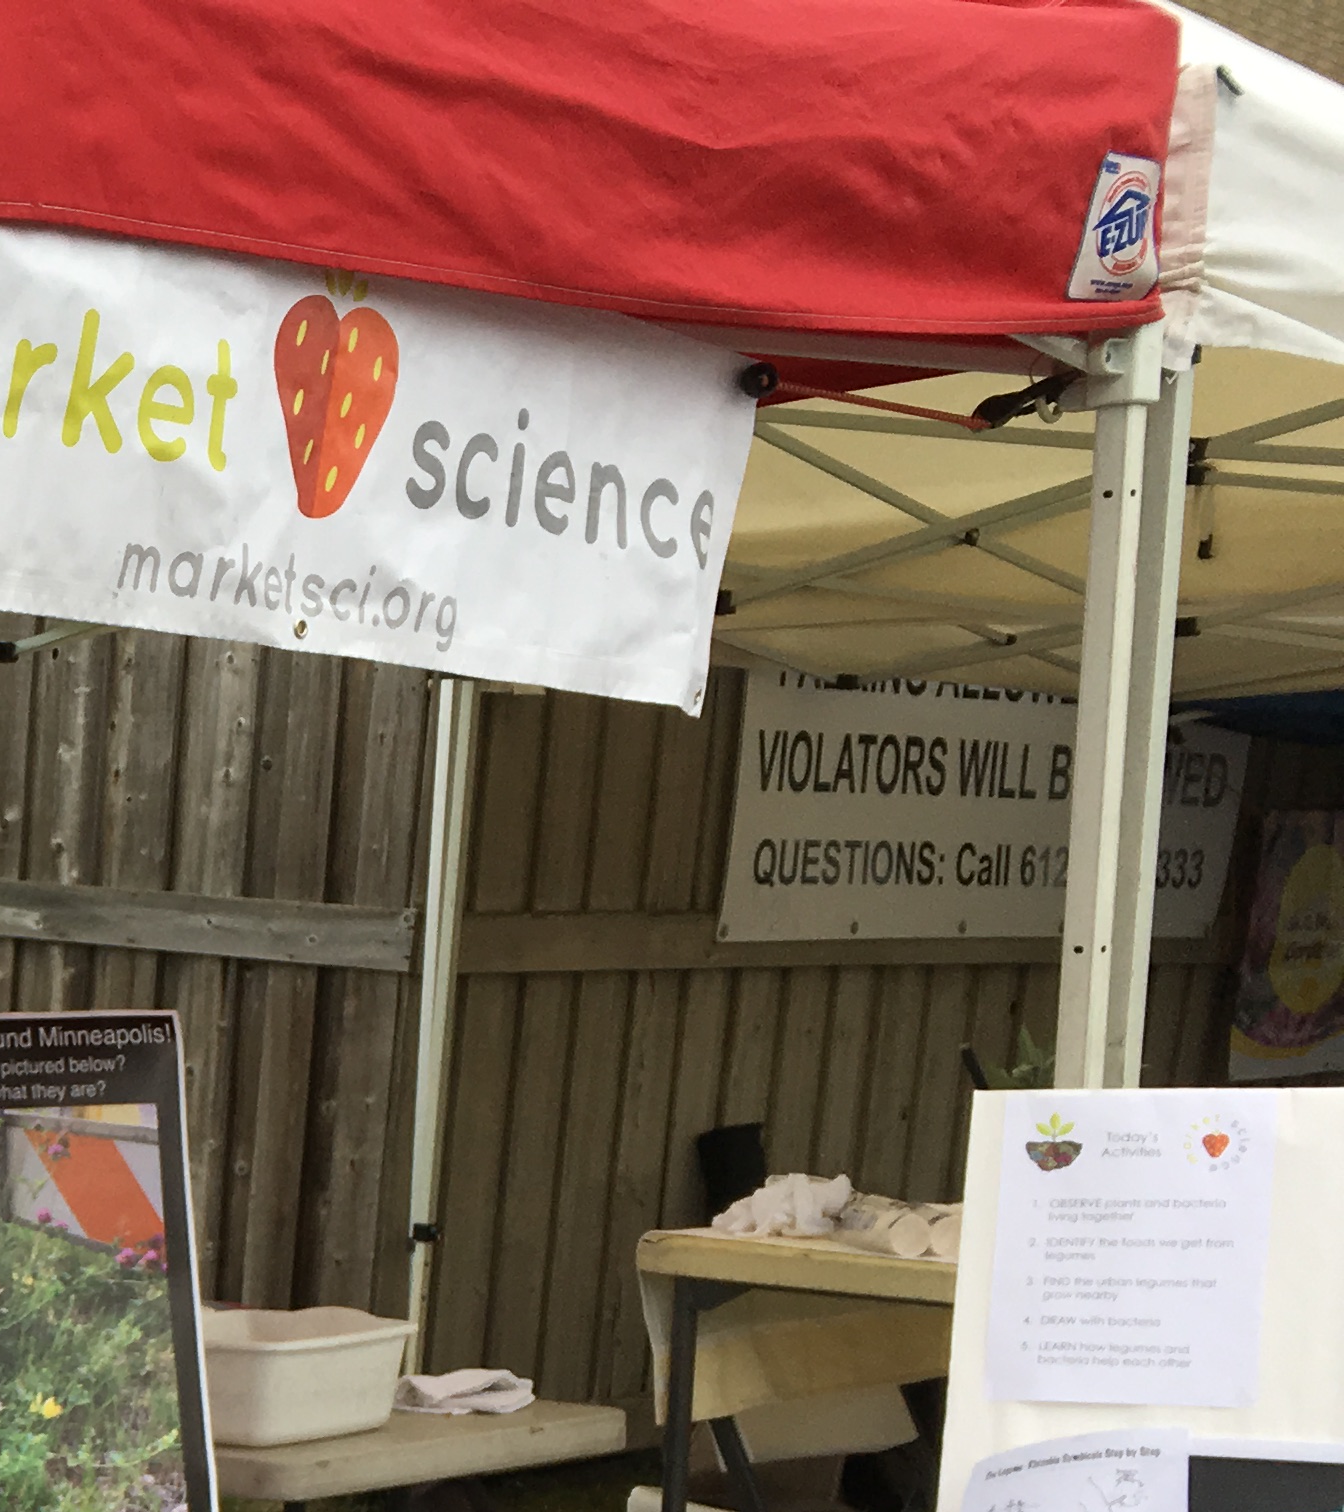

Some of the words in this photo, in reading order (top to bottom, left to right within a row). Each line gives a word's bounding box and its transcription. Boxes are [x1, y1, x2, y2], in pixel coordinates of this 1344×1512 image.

[404, 408, 714, 571] science
[116, 538, 459, 652] marketsci.org
[758, 729, 948, 797] VIOLATORS
[959, 738, 1038, 800] WILL
[1047, 744, 1073, 801] B
[753, 838, 946, 888] QUESTIONS:
[955, 842, 1013, 888] Call
[38, 1025, 172, 1048] Minneapolis!
[0, 1058, 65, 1078] pictured
[69, 1055, 125, 1073] below?
[30, 1084, 65, 1101] they
[70, 1083, 106, 1098] are?
